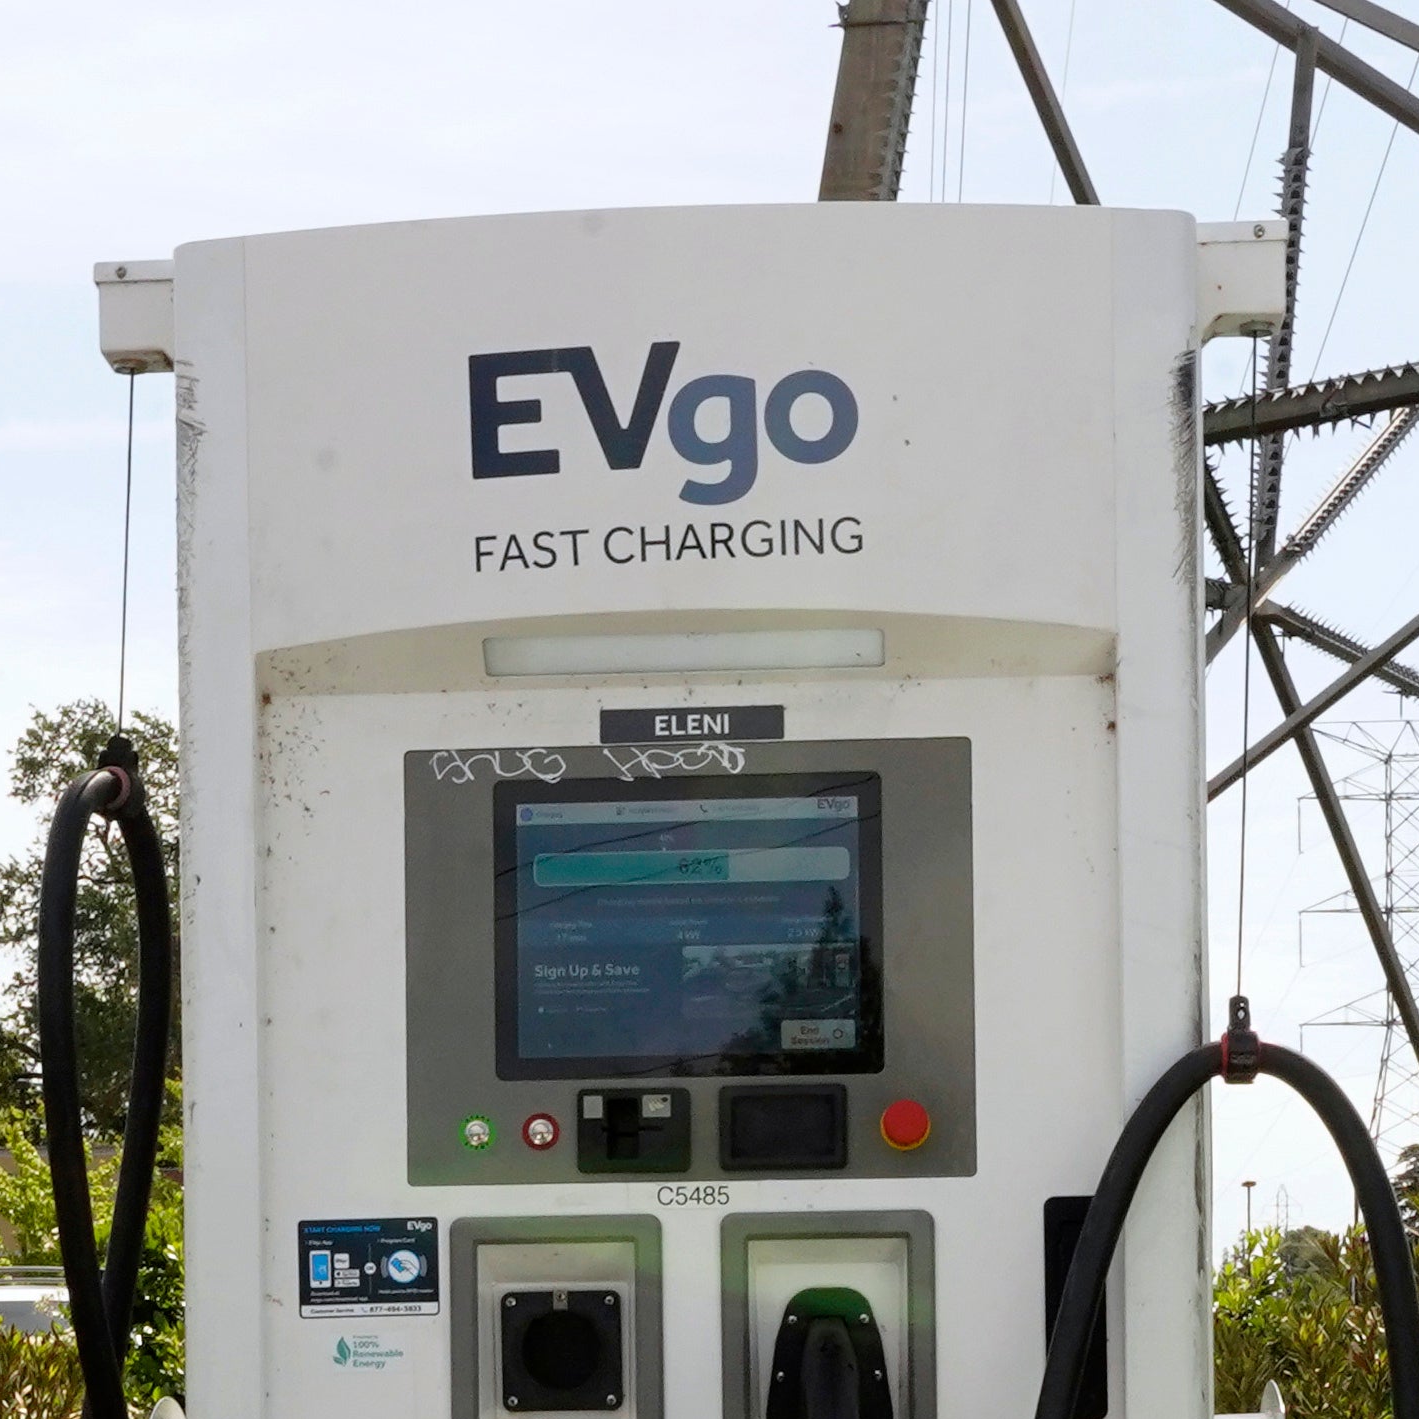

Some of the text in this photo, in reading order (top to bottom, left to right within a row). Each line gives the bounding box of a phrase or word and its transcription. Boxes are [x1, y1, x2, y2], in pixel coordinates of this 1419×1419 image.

[467, 340, 860, 506] EVgo
[474, 516, 864, 572] FAST CHARGING
[654, 712, 731, 736] ELENI
[534, 963, 641, 981] Sign Up & Save
[656, 1185, 731, 1206] C5485
[407, 1221, 433, 1232] EVgo
[353, 1360, 386, 1369] Energy
